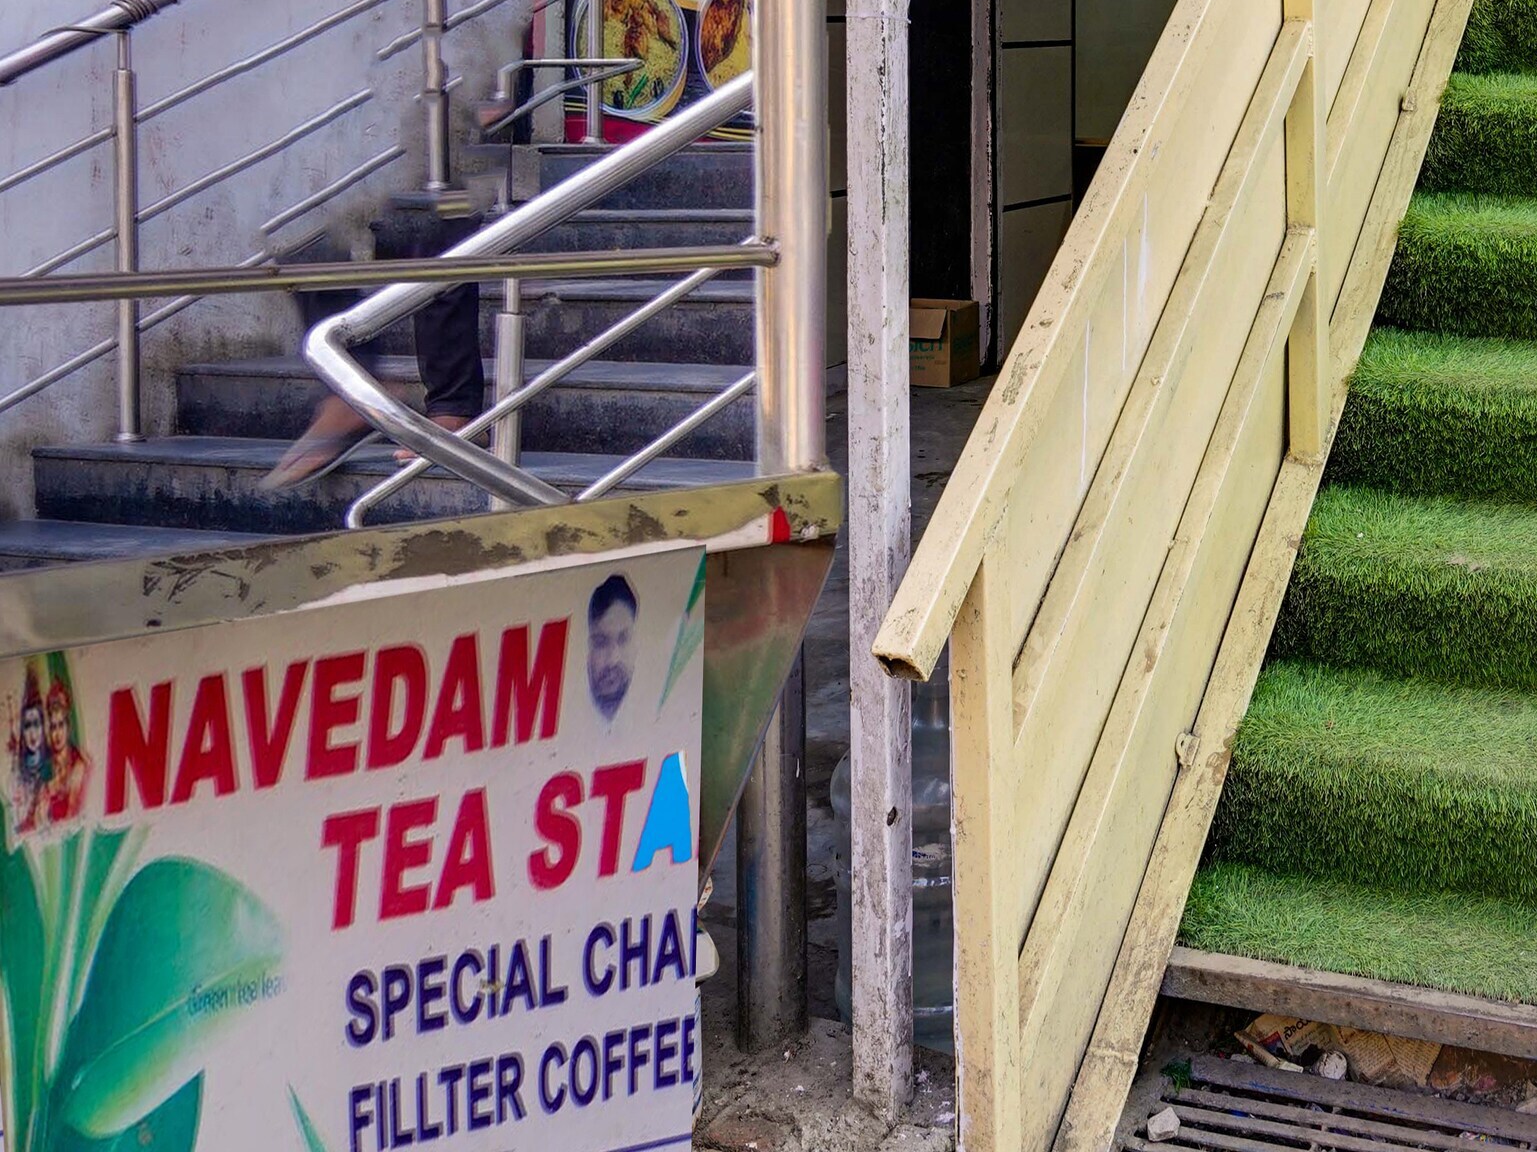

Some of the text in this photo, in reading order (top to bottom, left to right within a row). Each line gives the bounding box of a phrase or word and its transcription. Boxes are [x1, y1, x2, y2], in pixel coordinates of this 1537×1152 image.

[105, 615, 573, 816] NAVEDAM
[321, 751, 698, 932] TEA STA
[344, 933, 567, 1048] SPECIAL
[347, 1015, 695, 1152] FILLTER COFFEE
